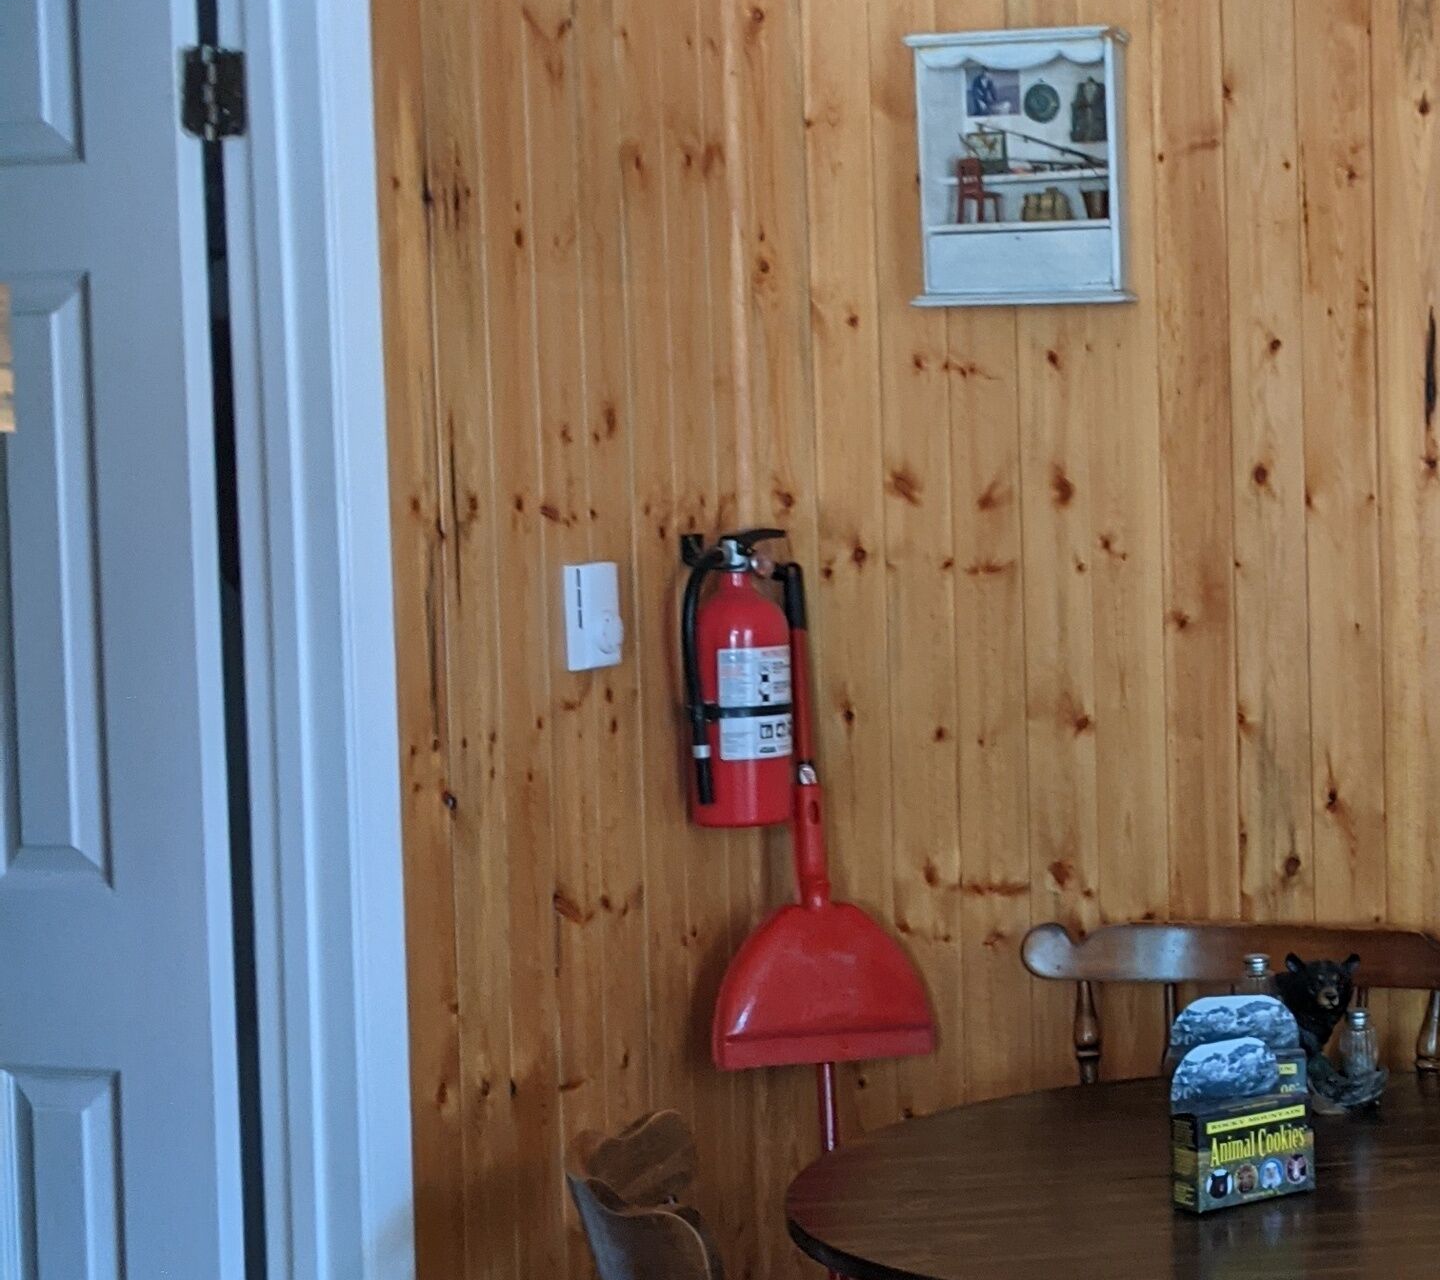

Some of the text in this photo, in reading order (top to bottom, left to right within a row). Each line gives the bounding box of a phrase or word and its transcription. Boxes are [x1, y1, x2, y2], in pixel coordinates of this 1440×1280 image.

[1210, 1108, 1301, 1131] ROCKY MOUNTAIN
[1210, 1131, 1256, 1167] Animal
[1257, 1124, 1305, 1157] Cookies
